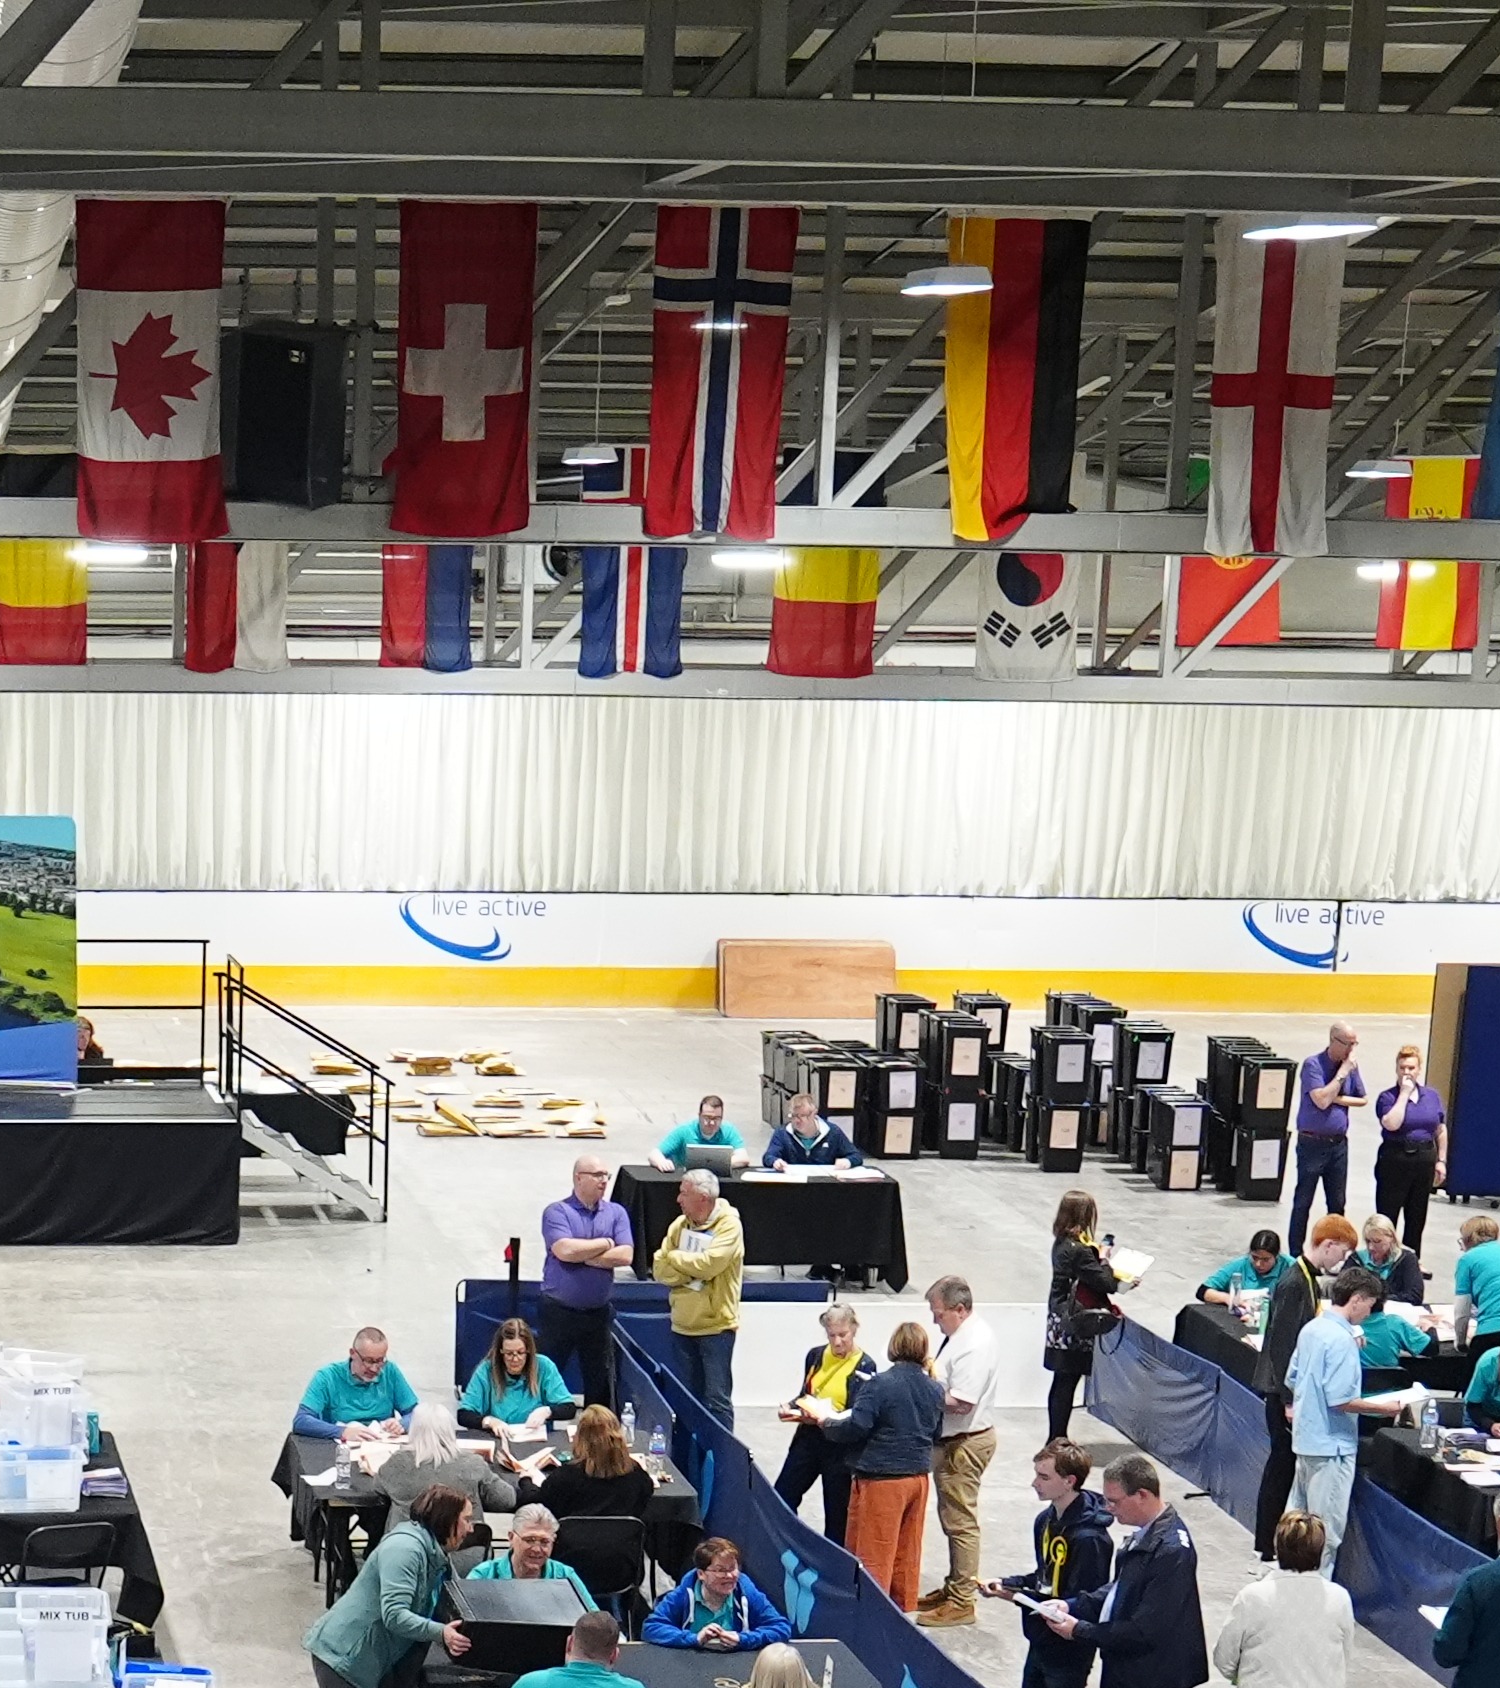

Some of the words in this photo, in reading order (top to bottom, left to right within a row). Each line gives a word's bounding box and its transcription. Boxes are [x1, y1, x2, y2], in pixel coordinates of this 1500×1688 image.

[432, 894, 468, 916] live
[478, 894, 547, 917] active
[1274, 902, 1310, 924] live
[1318, 903, 1386, 926] active
[33, 1387, 50, 1396] MIX
[53, 1387, 72, 1395] TUB
[39, 1611, 61, 1621] MIX
[64, 1611, 90, 1621] TUB
